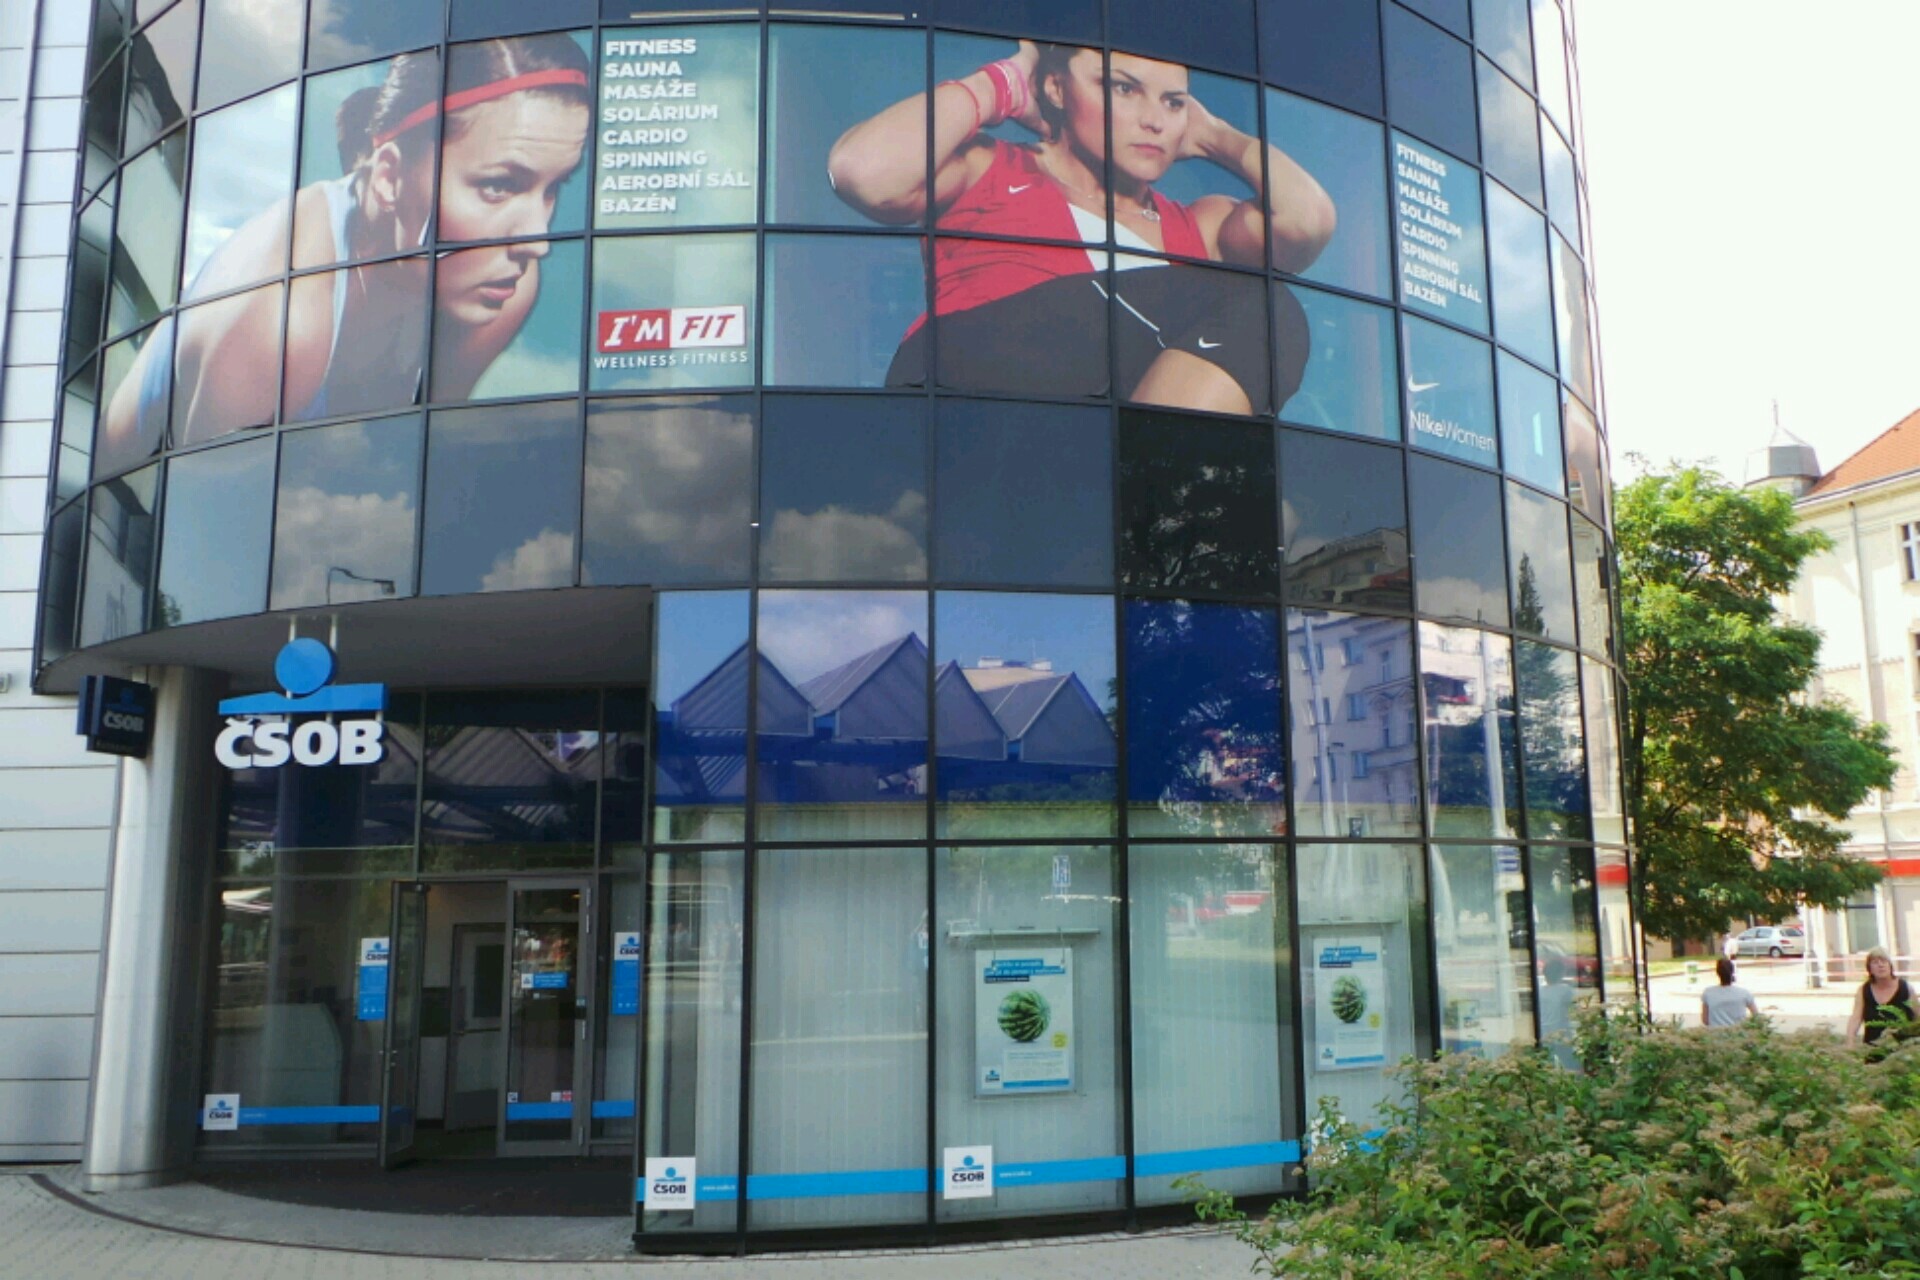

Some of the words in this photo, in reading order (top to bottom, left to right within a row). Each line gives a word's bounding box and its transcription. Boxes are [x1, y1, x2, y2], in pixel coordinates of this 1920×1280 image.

[606, 38, 696, 56] FITNESS
[604, 61, 682, 78] SAUNA
[603, 79, 697, 100] MASÁŽE
[602, 102, 718, 122] SOLÁRIUM
[602, 128, 688, 145] CARDIO
[602, 151, 708, 168] SPINNING
[1396, 142, 1446, 177] FITNESS
[601, 169, 700, 191] AEROBNÍ
[706, 168, 751, 187] SÁL
[1398, 163, 1440, 193] SAUNA
[600, 193, 677, 213] BAZÉN
[1399, 182, 1449, 215] MASÁŽE
[1400, 201, 1462, 239] SOLÁRIUM
[1401, 222, 1447, 251] CARDIO
[1401, 241, 1460, 275] SPINNING
[1403, 261, 1458, 293] AEROBNÍ
[1459, 282, 1482, 303] SÁL
[1403, 280, 1447, 308] BAZÉN
[604, 315, 664, 347] I'M
[680, 314, 735, 340] FIT
[594, 353, 677, 369] WELLNESS
[683, 351, 748, 365] FITNESS
[1410, 410, 1496, 452] NikeWomen
[103, 710, 144, 732] ČSOB
[215, 717, 384, 769] ČSOB
[952, 1171, 985, 1182] ČSOB
[653, 1184, 686, 1194] ČSOB
